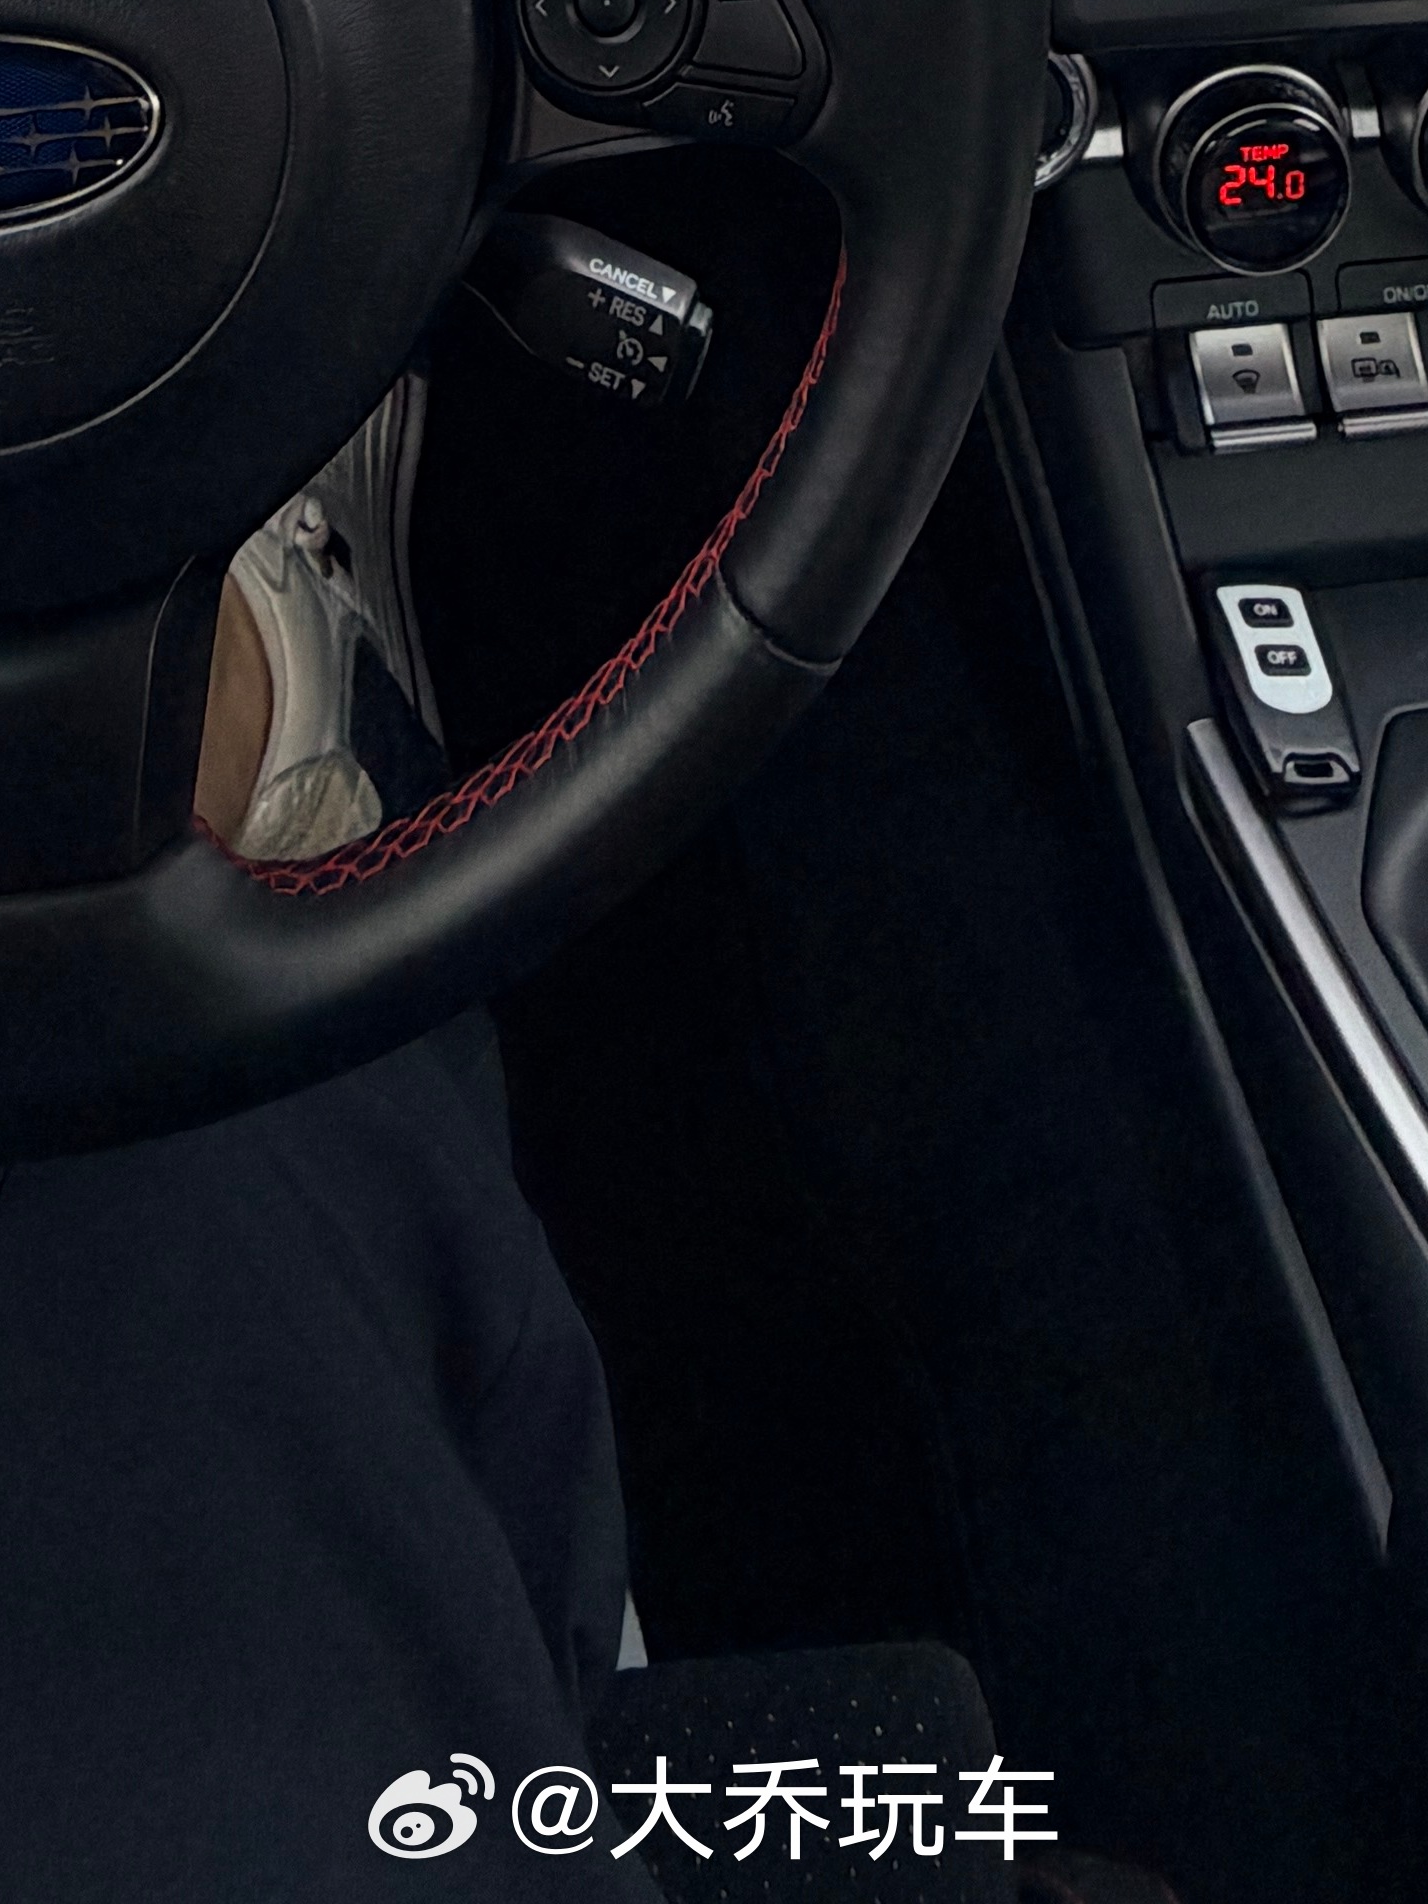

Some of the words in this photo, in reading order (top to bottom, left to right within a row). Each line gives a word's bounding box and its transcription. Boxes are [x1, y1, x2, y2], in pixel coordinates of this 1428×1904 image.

[1240, 142, 1290, 161] TEMP
[1219, 165, 1305, 207] 24.0
[588, 257, 660, 300] CANCEL
[1206, 299, 1260, 319] AUTO
[1253, 602, 1278, 617] ON
[1266, 650, 1298, 665] OFF
